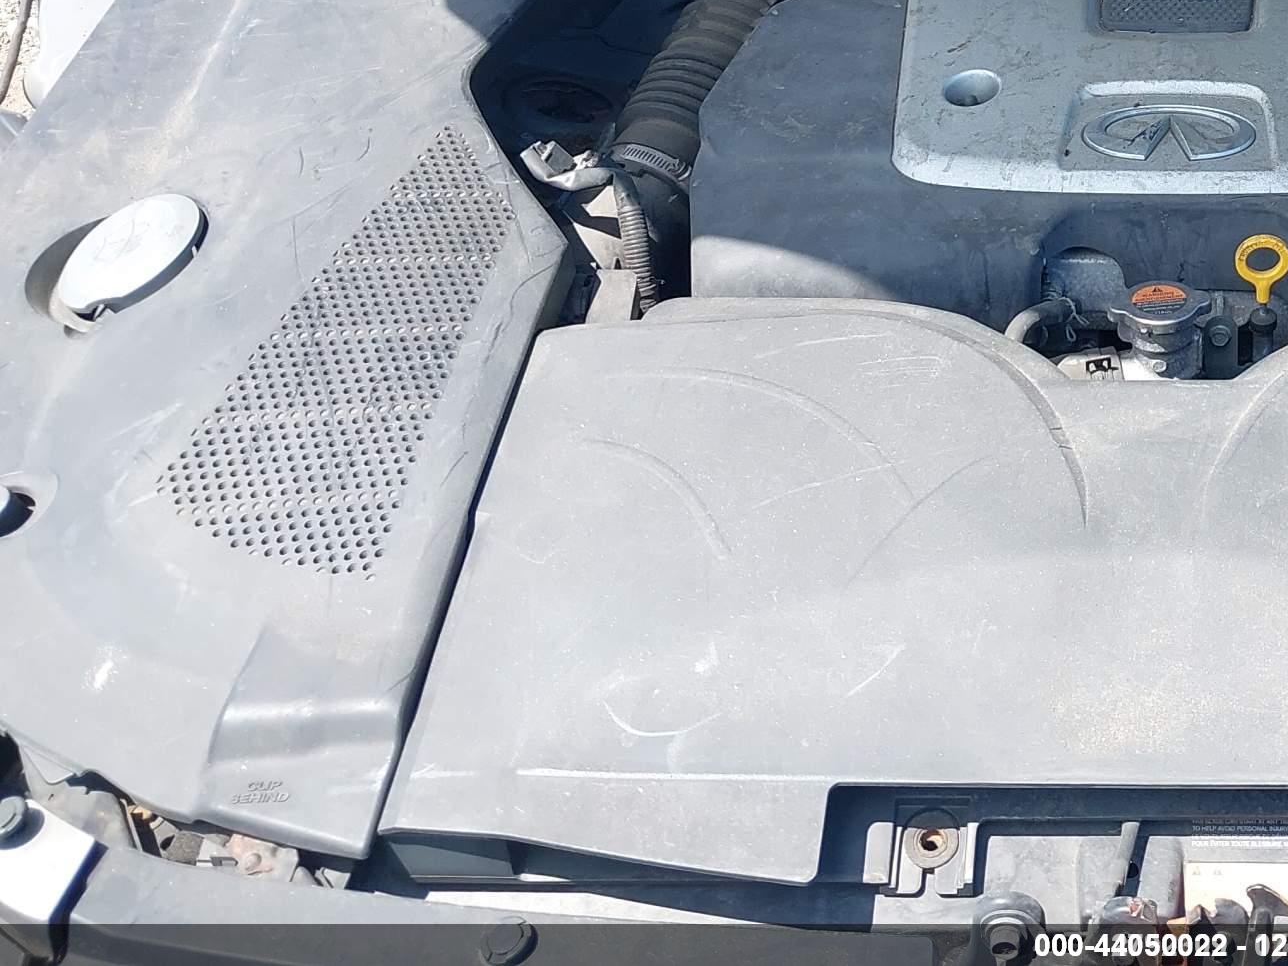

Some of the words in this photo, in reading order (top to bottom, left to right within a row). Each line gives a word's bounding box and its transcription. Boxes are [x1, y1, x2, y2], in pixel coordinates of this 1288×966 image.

[247, 780, 283, 792] CLIP
[231, 792, 290, 805] BEHIND
[1236, 825, 1269, 833] PERSONAL
